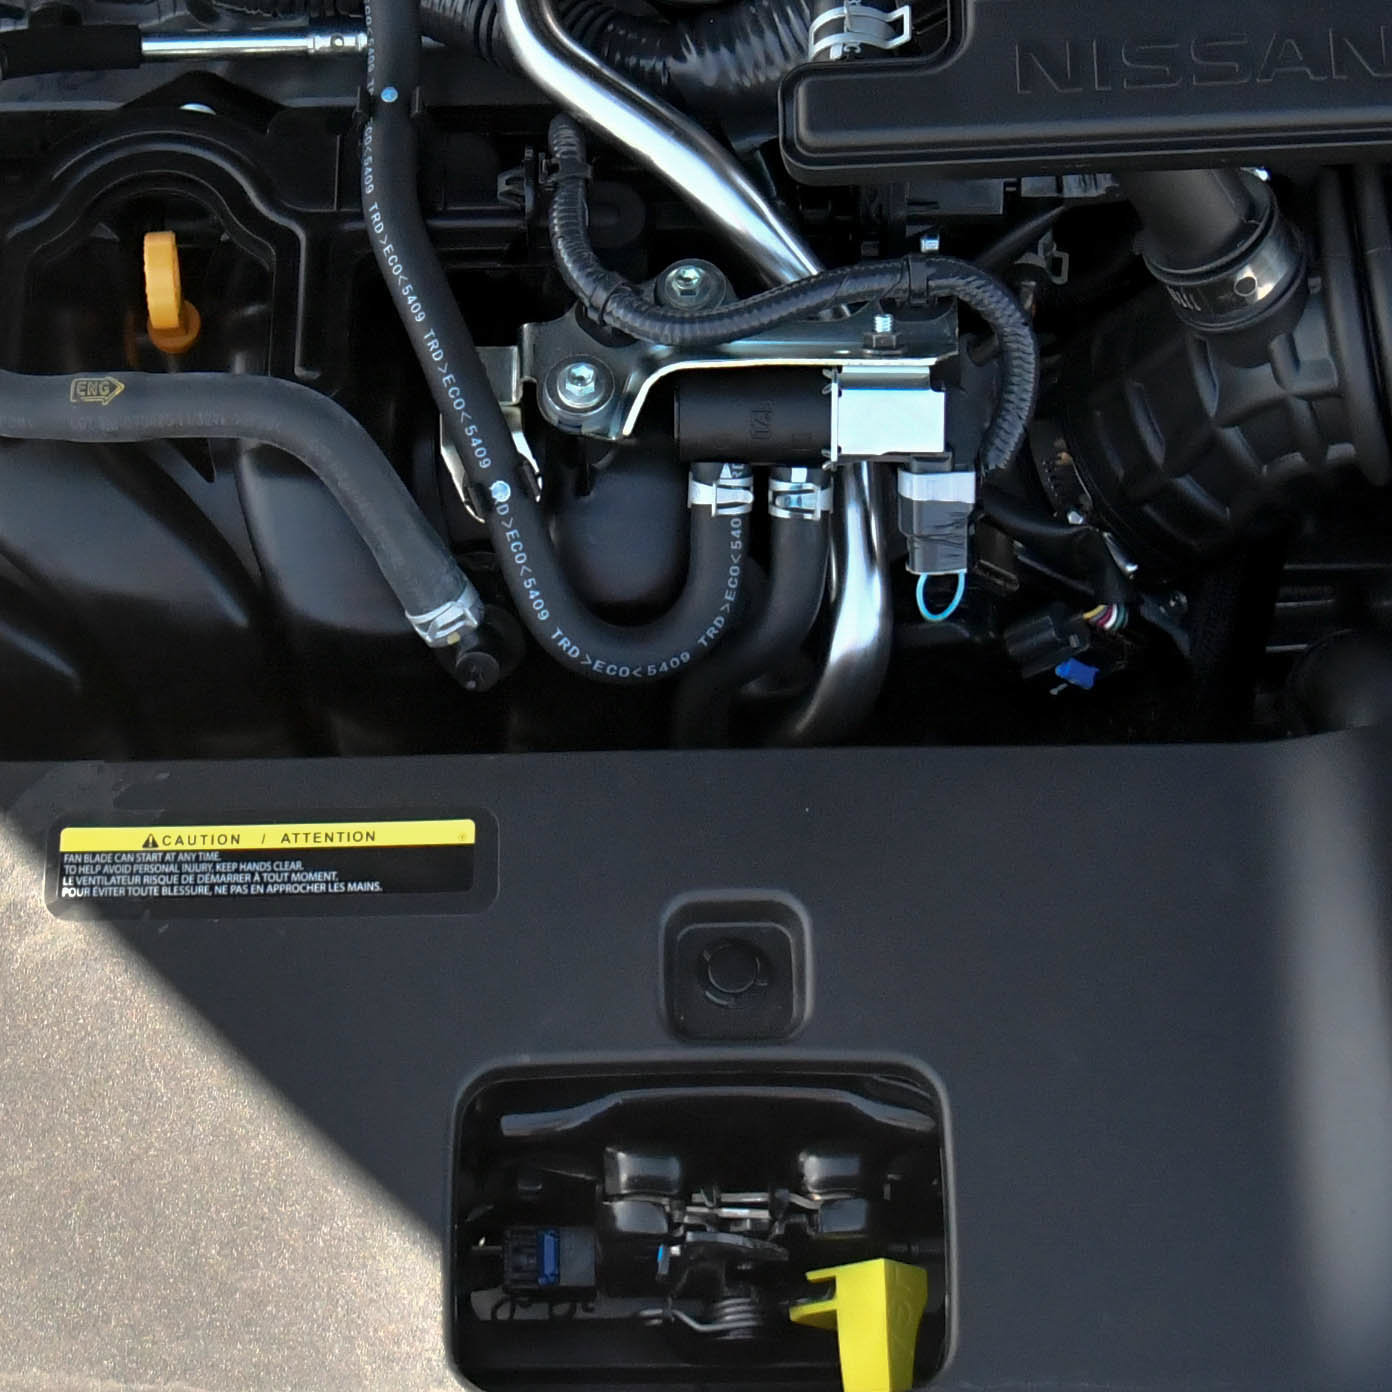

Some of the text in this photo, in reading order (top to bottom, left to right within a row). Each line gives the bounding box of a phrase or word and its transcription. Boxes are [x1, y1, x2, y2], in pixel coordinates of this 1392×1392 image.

[77, 382, 109, 396] ENG
[162, 834, 240, 846] CAUTION
[281, 831, 375, 844] ATTENTION
[64, 854, 82, 863] FAN
[84, 853, 112, 863] BLADE
[115, 853, 134, 862] CAN
[136, 853, 163, 862] START
[164, 853, 176, 861] AT
[178, 852, 197, 861] ANY
[64, 865, 76, 874] TO
[79, 864, 101, 874] HELP
[103, 864, 131, 873] AVOID
[133, 863, 179, 873] PERSONAL
[216, 862, 237, 872] KEEP
[240, 861, 271, 871] HANDS
[63, 877, 74, 886] LE
[76, 875, 141, 885] VENTILATEUR
[143, 875, 178, 885] RISQUE
[181, 875, 195, 883] DE
[262, 872, 289, 881] TOUT
[62, 888, 90, 897] POUR
[93, 886, 125, 896] ÉVITER
[127, 887, 159, 896] TOUTE
[214, 885, 228, 894] NE
[231, 885, 248, 894] PAS
[250, 884, 263, 893] EN
[266, 883, 326, 893] APPROCHER
[329, 882, 345, 892] LES
